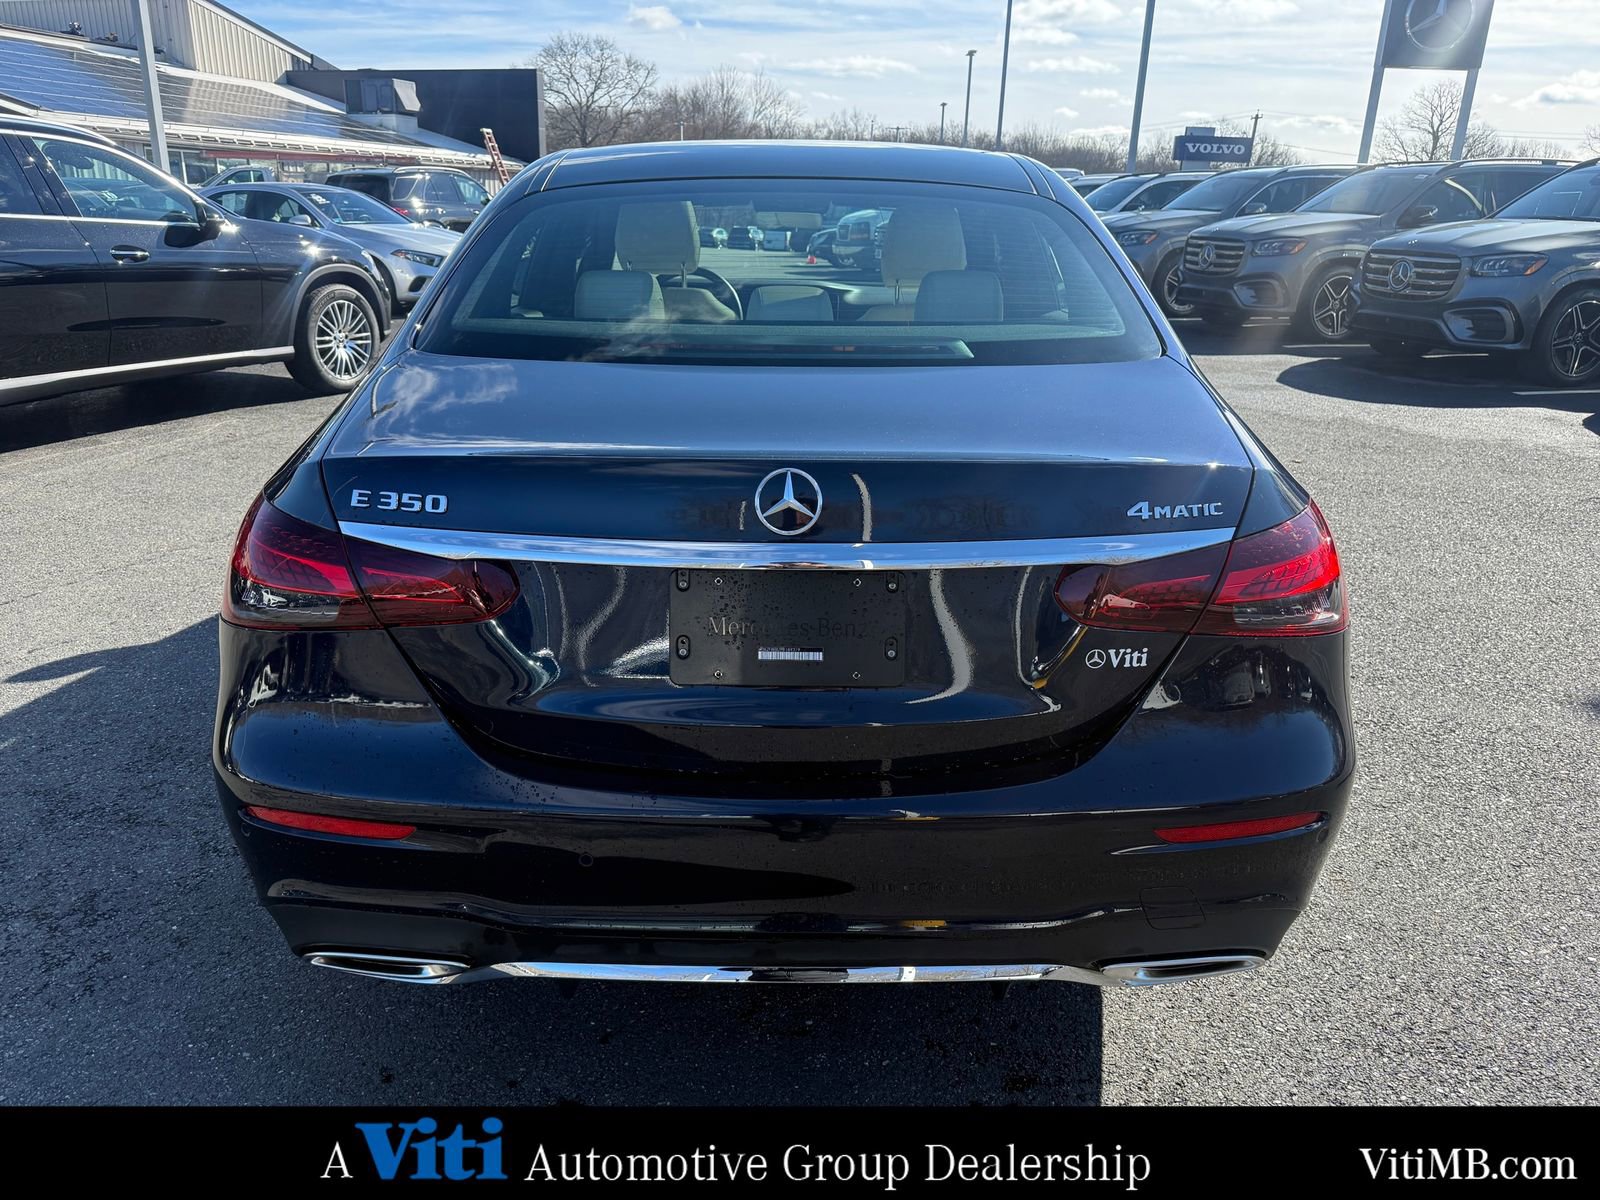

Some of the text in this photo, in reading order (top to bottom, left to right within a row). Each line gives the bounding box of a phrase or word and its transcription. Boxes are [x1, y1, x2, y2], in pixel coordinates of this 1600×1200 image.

[1185, 143, 1246, 154] VOLVO
[350, 489, 448, 513] E 350
[1126, 501, 1224, 520] 4MATIC
[1107, 647, 1149, 668] Viti
